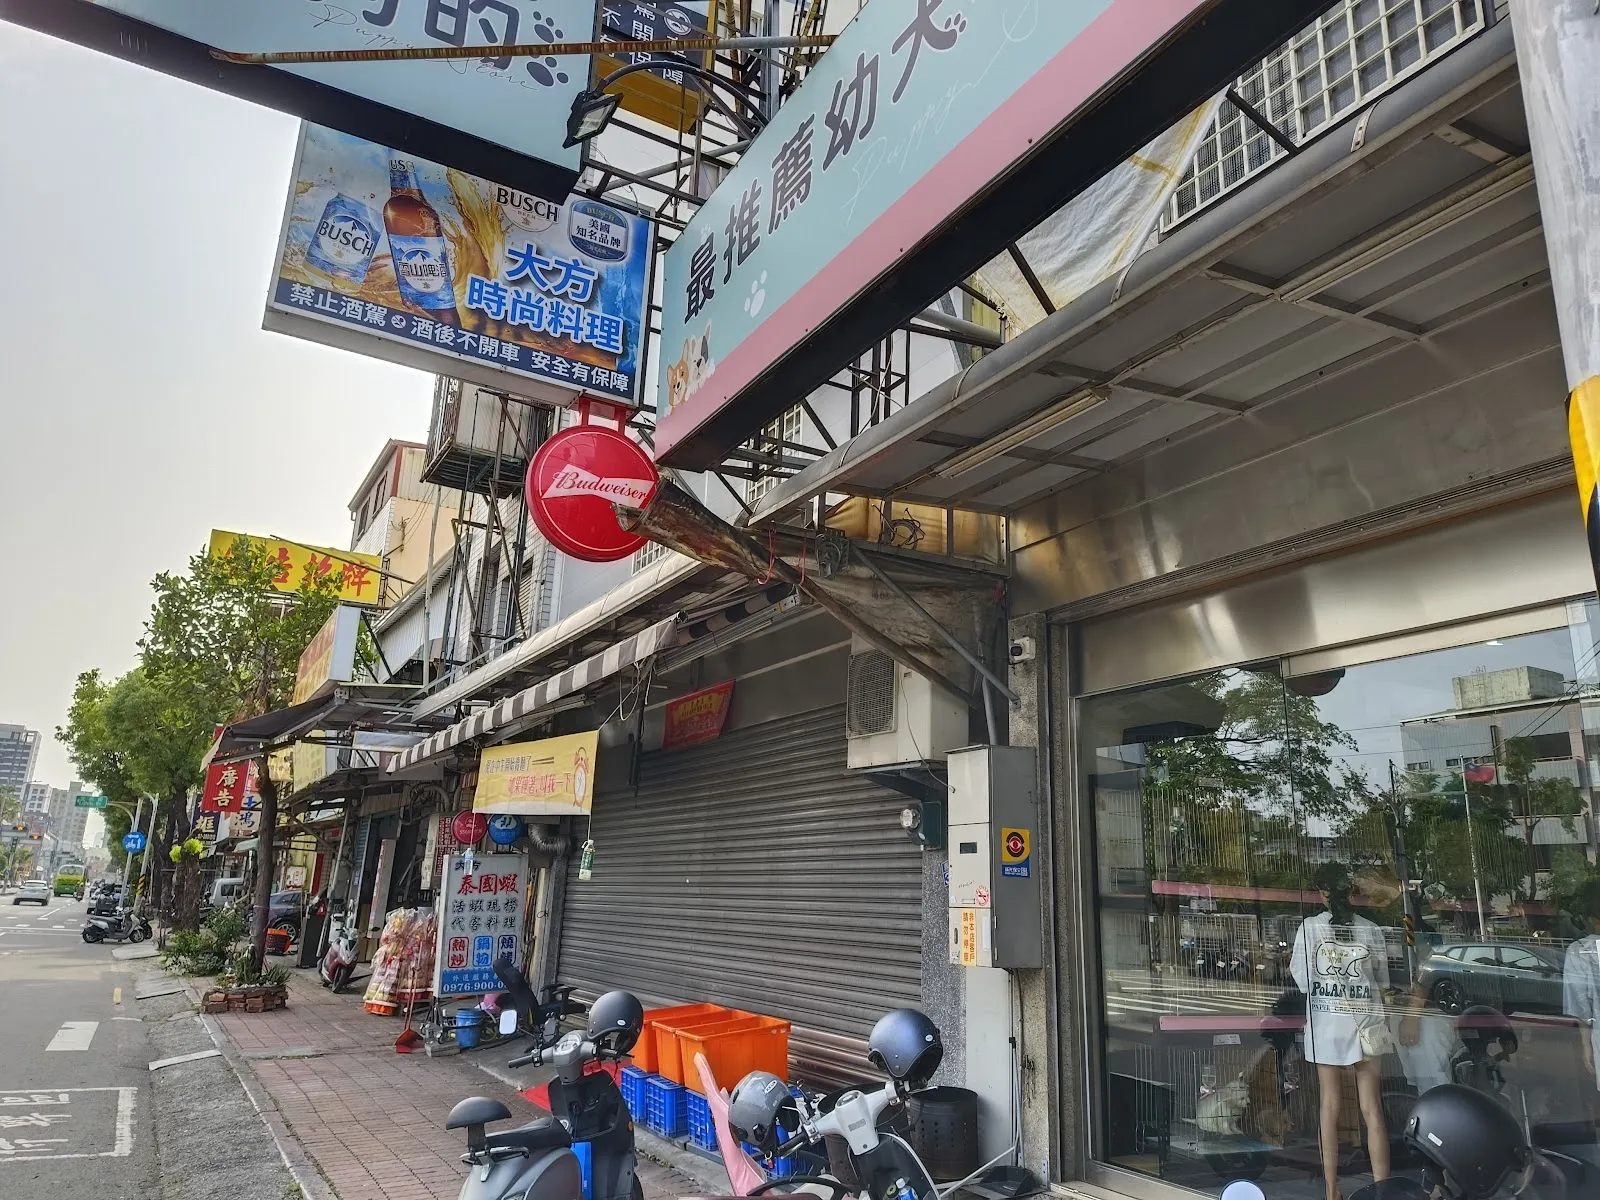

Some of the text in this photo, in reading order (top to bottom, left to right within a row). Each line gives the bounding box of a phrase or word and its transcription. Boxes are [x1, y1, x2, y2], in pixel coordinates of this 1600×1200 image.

[496, 186, 559, 222] BUSCH
[318, 219, 375, 258] BUSCH
[576, 225, 622, 249] 知名品牌
[588, 217, 612, 235] 美國
[507, 242, 598, 302] 大方
[466, 276, 625, 354] 時尚料理
[289, 283, 630, 393] 禁止酒駕 酒後不開車 安全有保障
[552, 471, 648, 501] Budweiser
[457, 873, 520, 896] 泰國蝦
[451, 915, 517, 933] 代客料理
